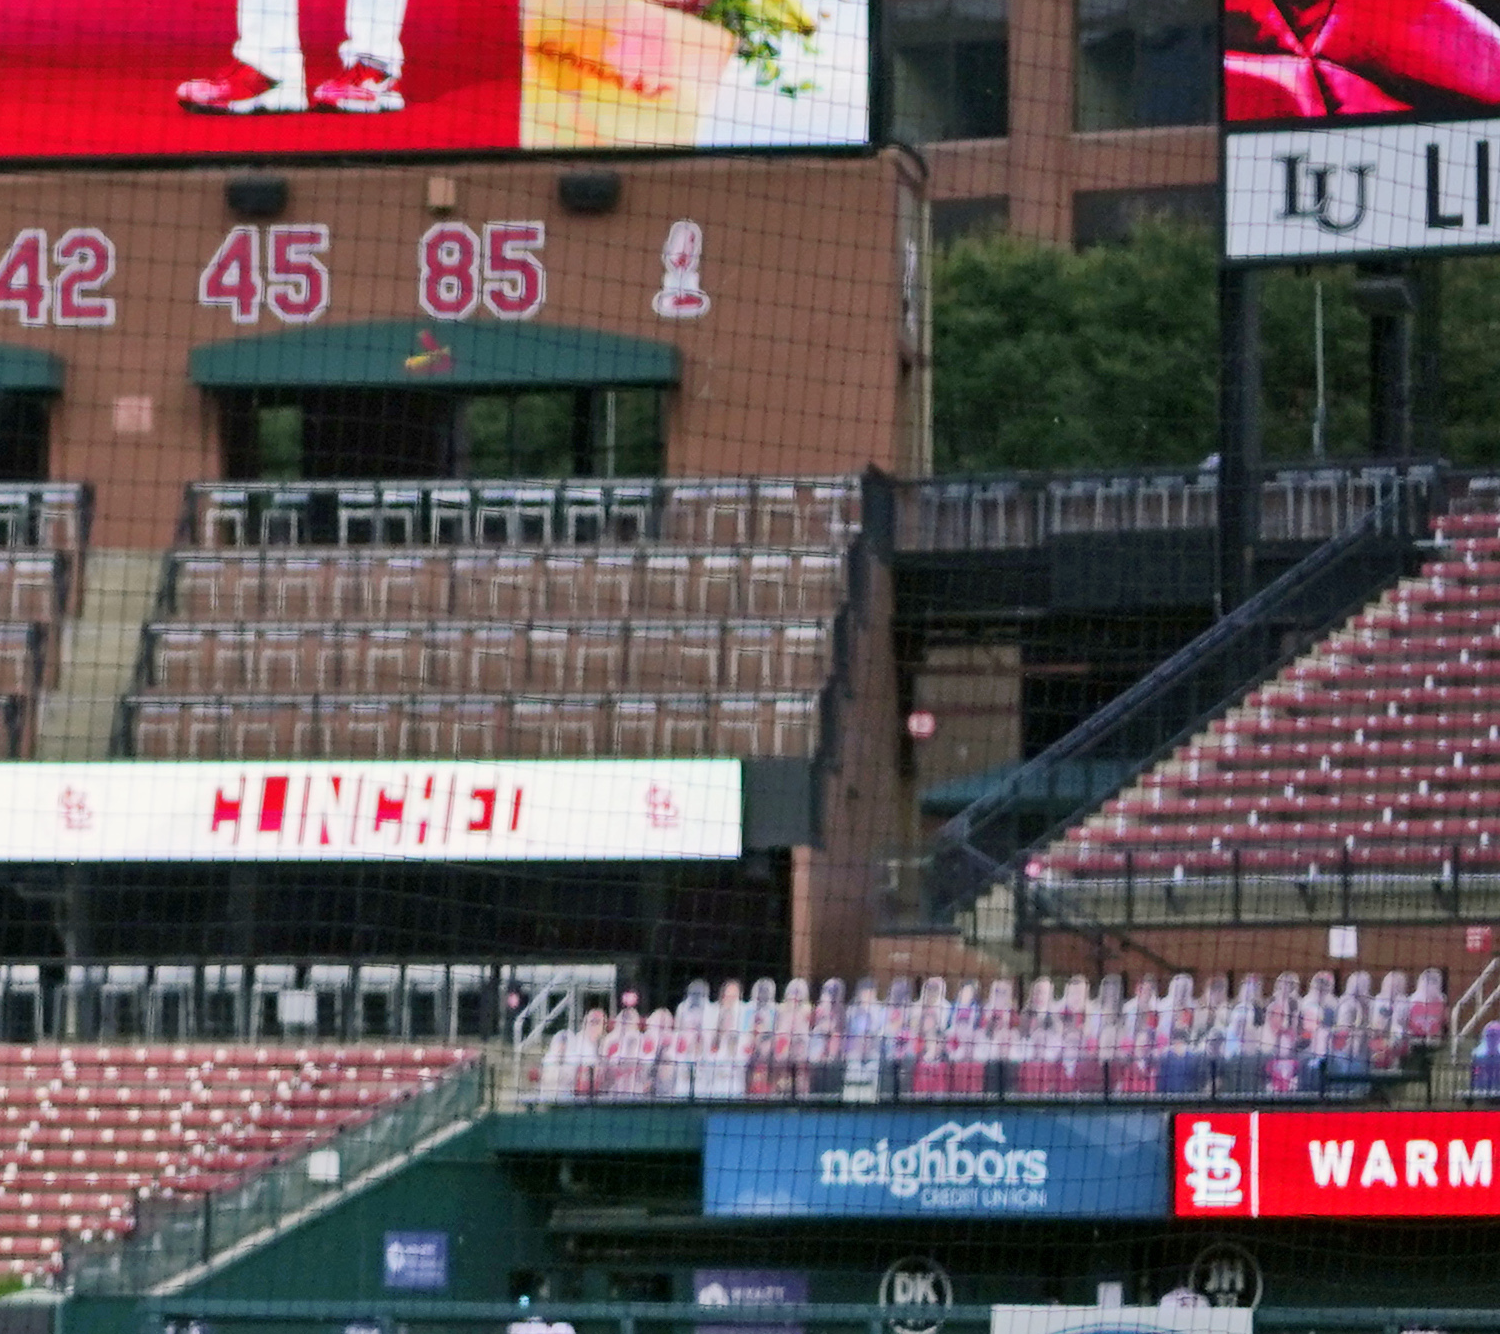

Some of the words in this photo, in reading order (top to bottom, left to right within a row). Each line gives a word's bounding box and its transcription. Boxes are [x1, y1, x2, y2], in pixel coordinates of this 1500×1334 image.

[199, 224, 330, 323] 45
[418, 220, 547, 320] 85
[820, 1137, 1048, 1197] neighbors
[1308, 1139, 1492, 1187] WARM
[921, 1187, 977, 1208] CREDIT
[982, 1187, 1047, 1208] UNION
